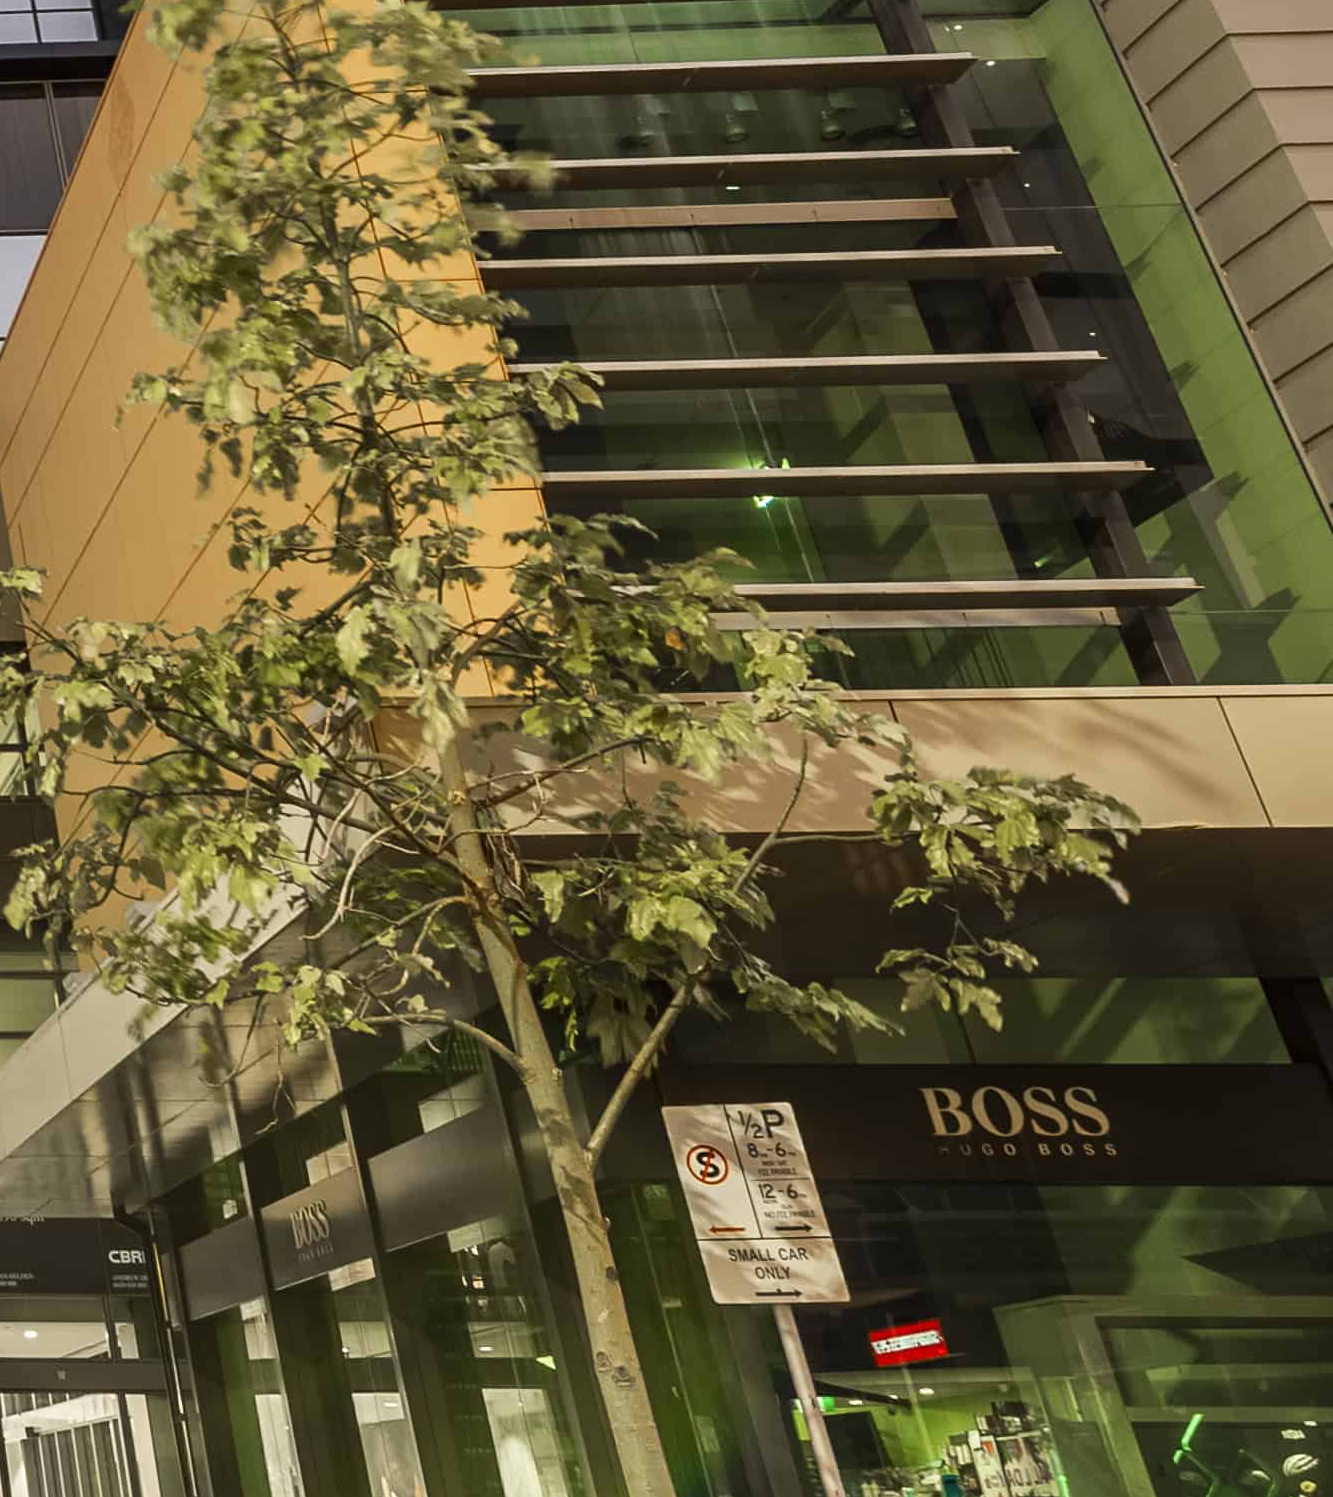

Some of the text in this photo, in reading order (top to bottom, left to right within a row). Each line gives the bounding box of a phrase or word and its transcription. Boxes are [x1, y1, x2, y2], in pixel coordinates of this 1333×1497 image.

[918, 1085, 1111, 1138] BOSS
[1037, 1142, 1118, 1156] BOSS
[290, 1198, 330, 1249] BOSS
[728, 1247, 808, 1262] SMALL CAR
[754, 1266, 790, 1280] ONLY
